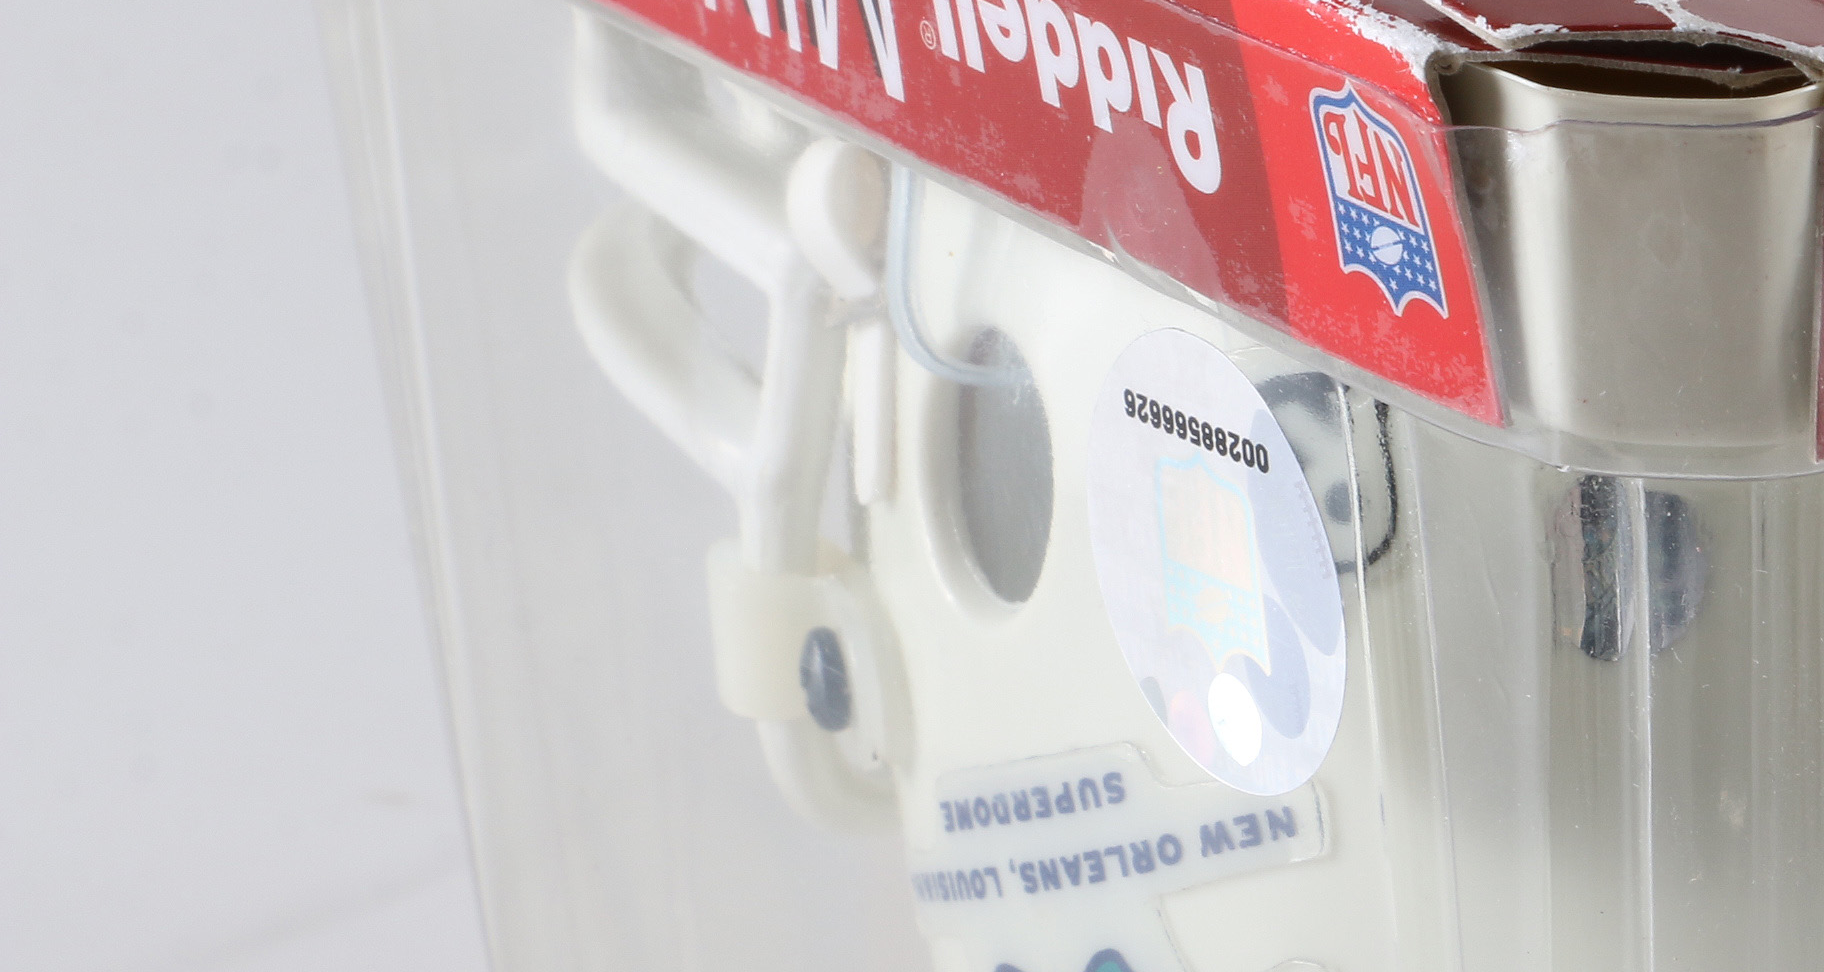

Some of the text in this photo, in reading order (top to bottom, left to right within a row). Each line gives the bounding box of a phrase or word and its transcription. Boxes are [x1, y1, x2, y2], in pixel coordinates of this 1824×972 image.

[1323, 109, 1422, 229] NFL
[1123, 387, 1270, 475] 00288566626
[938, 771, 1127, 833] SUPERDOME
[911, 805, 1300, 902] NEW ORLEANS, LOUISI
